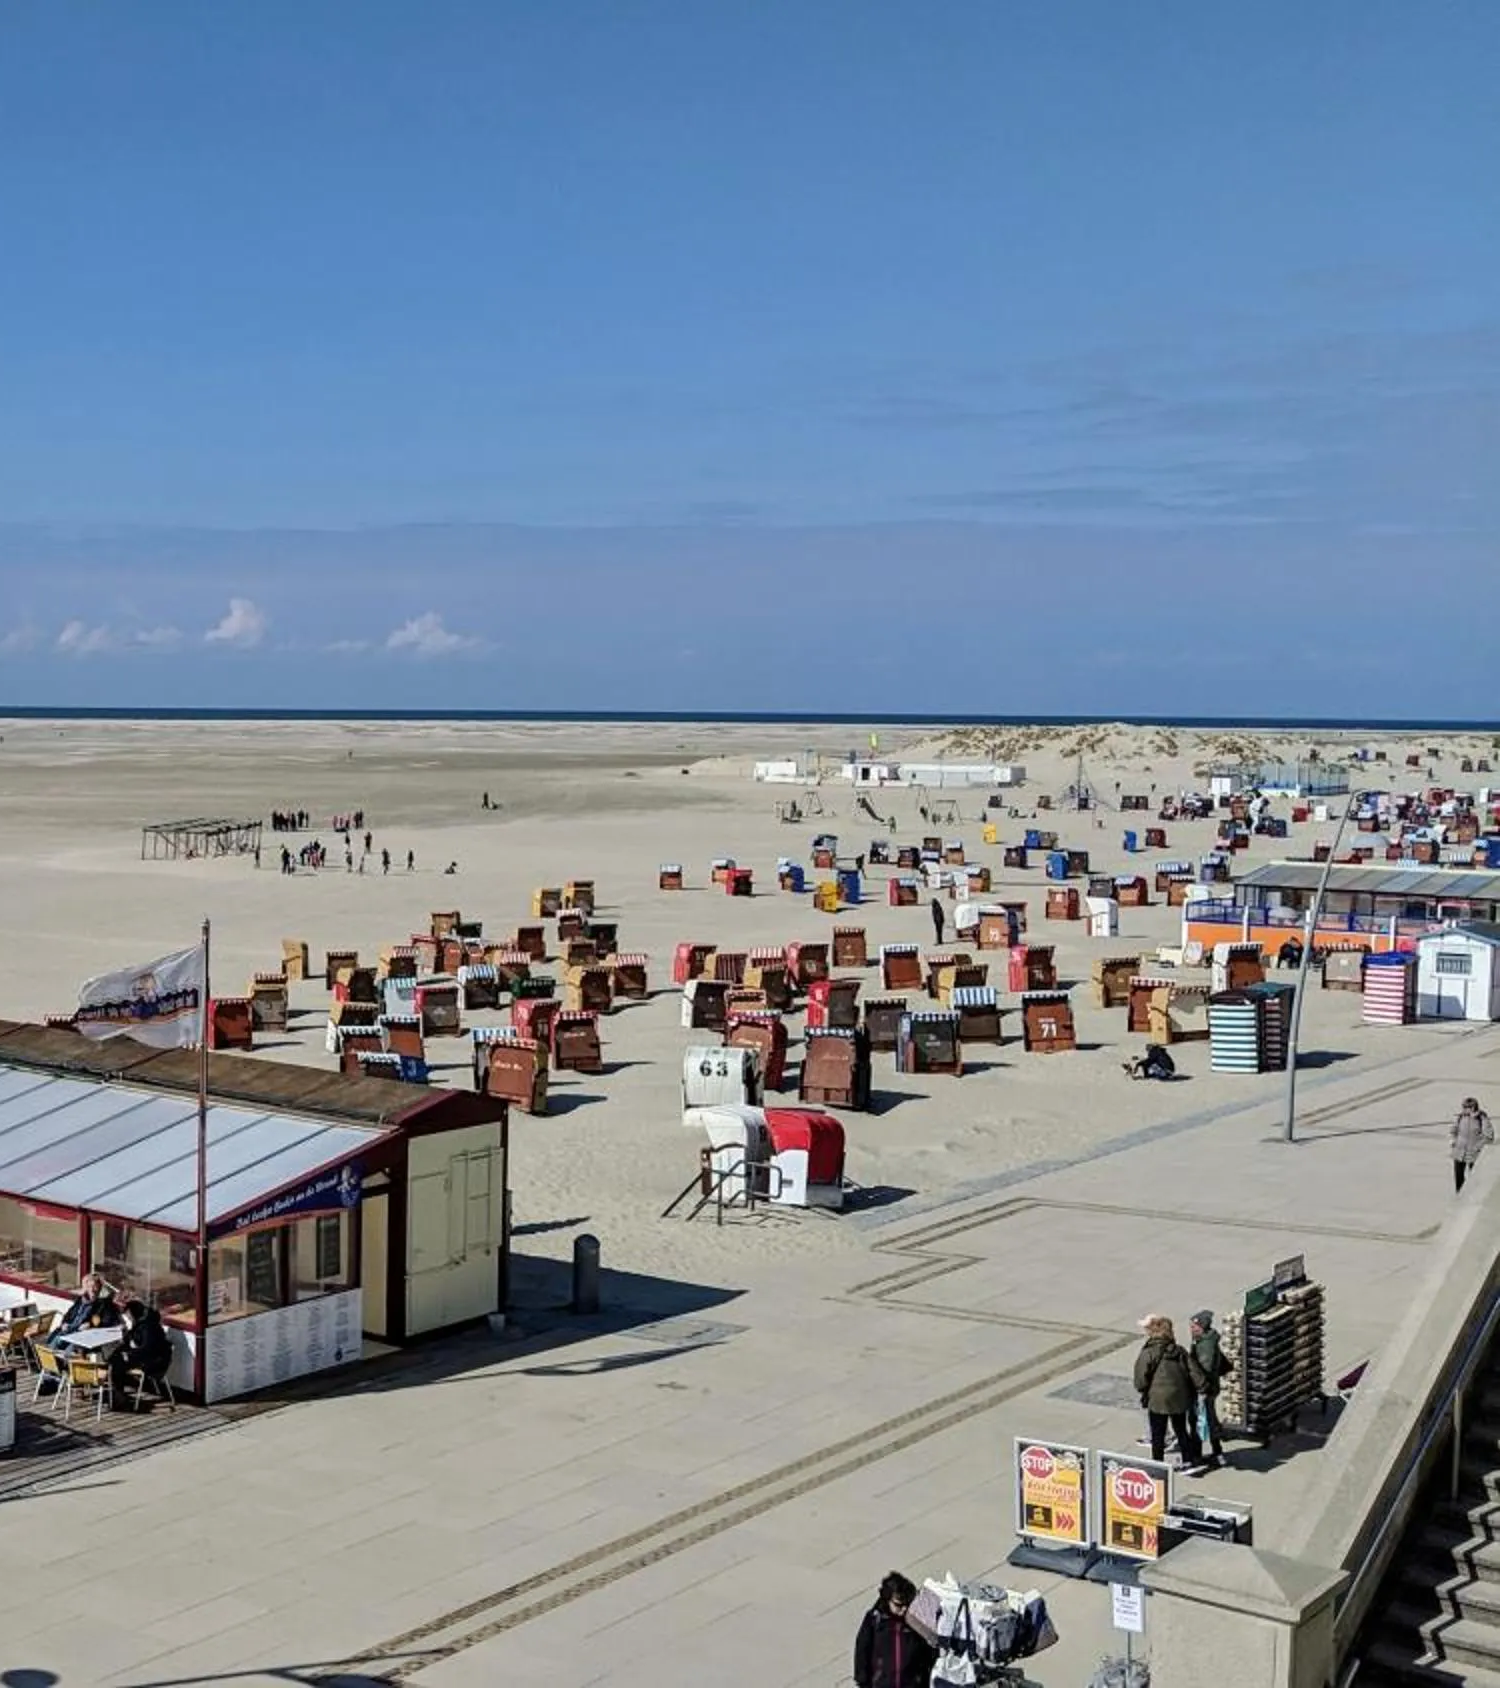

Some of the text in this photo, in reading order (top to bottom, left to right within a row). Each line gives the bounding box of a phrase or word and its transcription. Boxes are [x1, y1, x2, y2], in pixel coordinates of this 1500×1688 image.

[699, 1060, 729, 1077] 63
[1021, 1456, 1052, 1473] STOP
[1116, 1480, 1153, 1501] STOP
